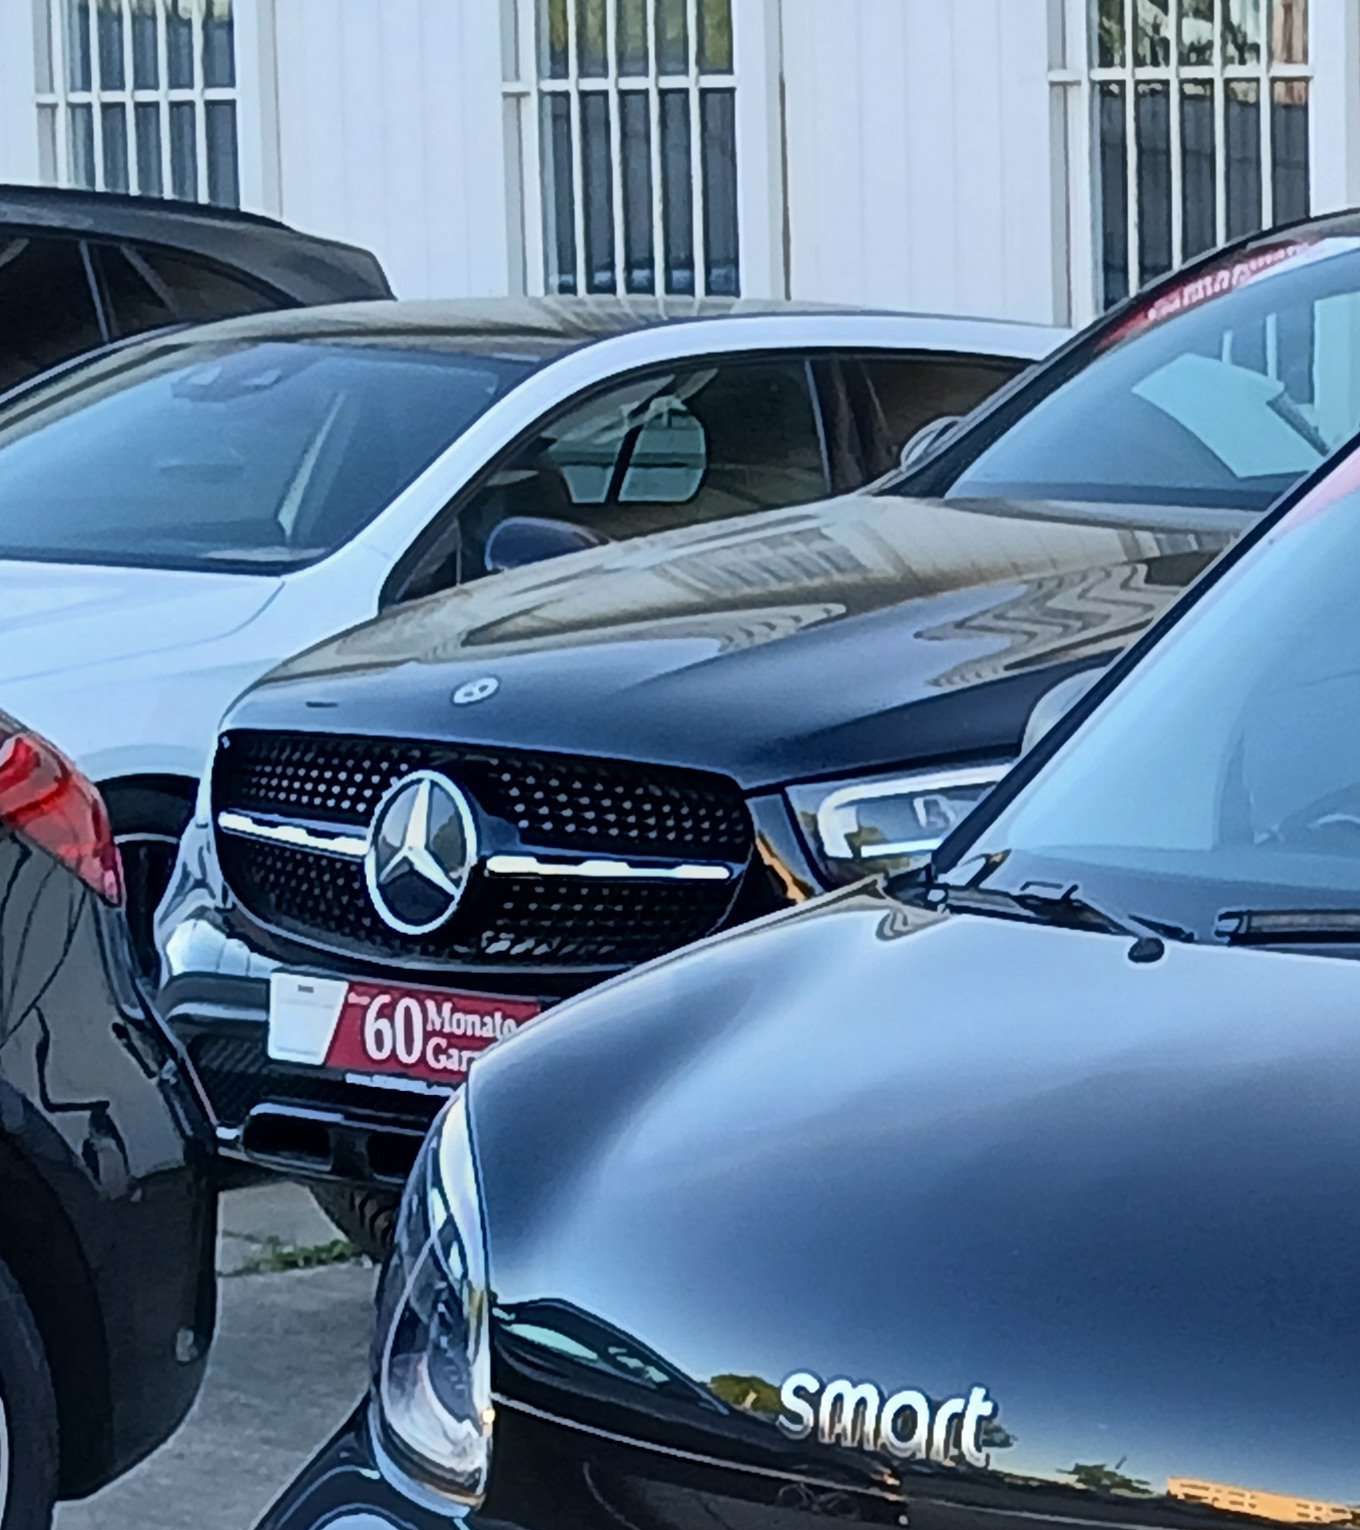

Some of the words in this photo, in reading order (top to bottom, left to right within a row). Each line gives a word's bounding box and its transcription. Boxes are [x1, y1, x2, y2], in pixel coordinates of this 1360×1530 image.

[364, 994, 424, 1065] 60
[426, 1036, 477, 1072] Gar
[776, 1371, 995, 1468] smart
